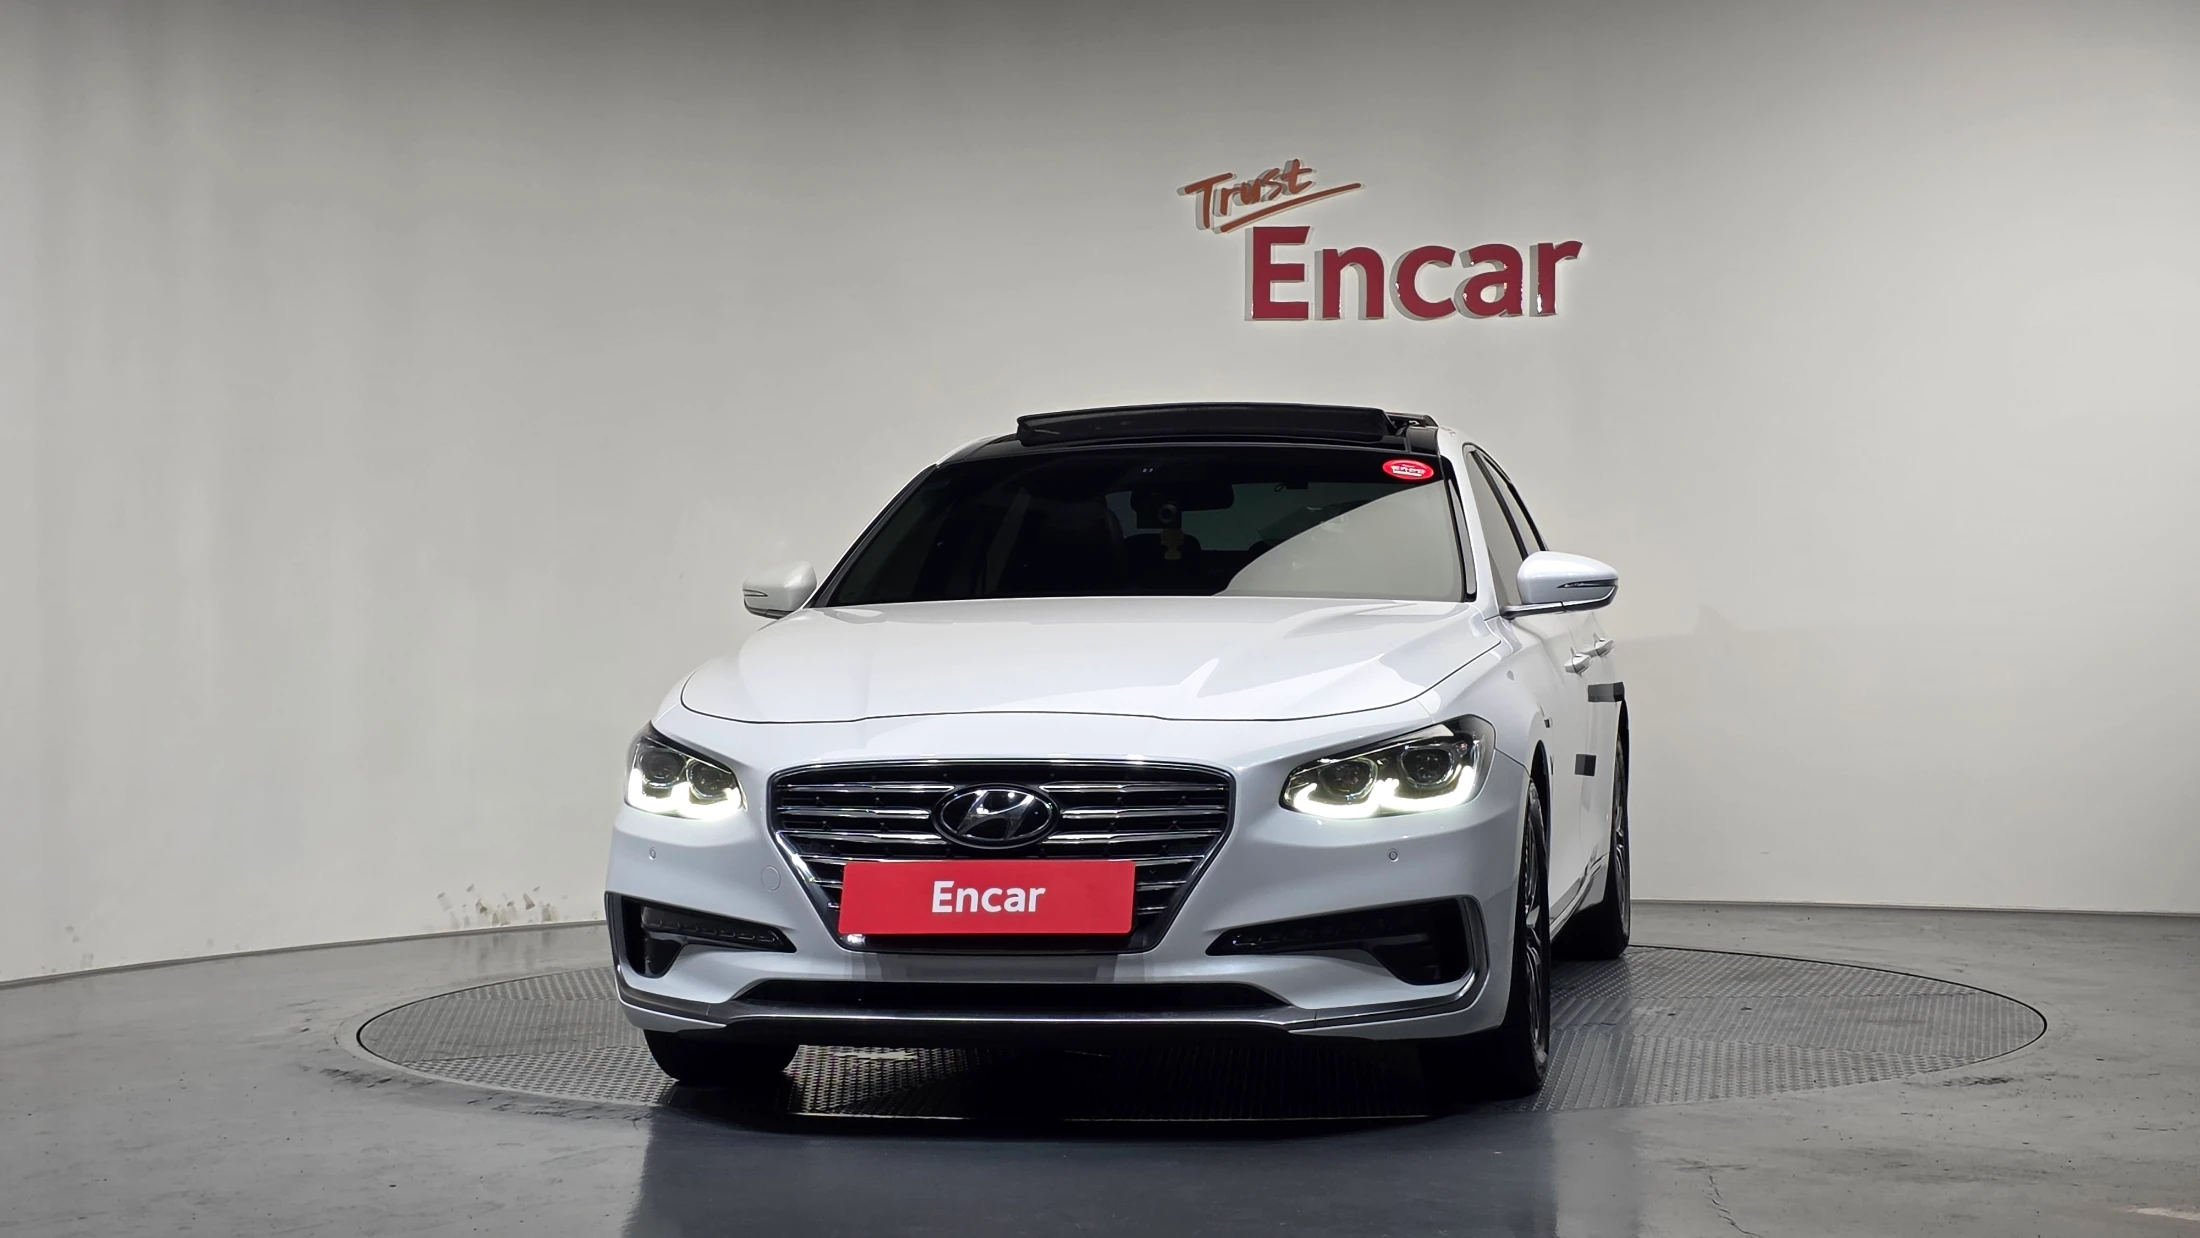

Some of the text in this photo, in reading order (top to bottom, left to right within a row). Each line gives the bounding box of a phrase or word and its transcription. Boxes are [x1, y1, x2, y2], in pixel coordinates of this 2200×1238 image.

[1182, 159, 1313, 230] Trust
[1248, 225, 1583, 320] Encar
[931, 880, 1046, 913] Encar
